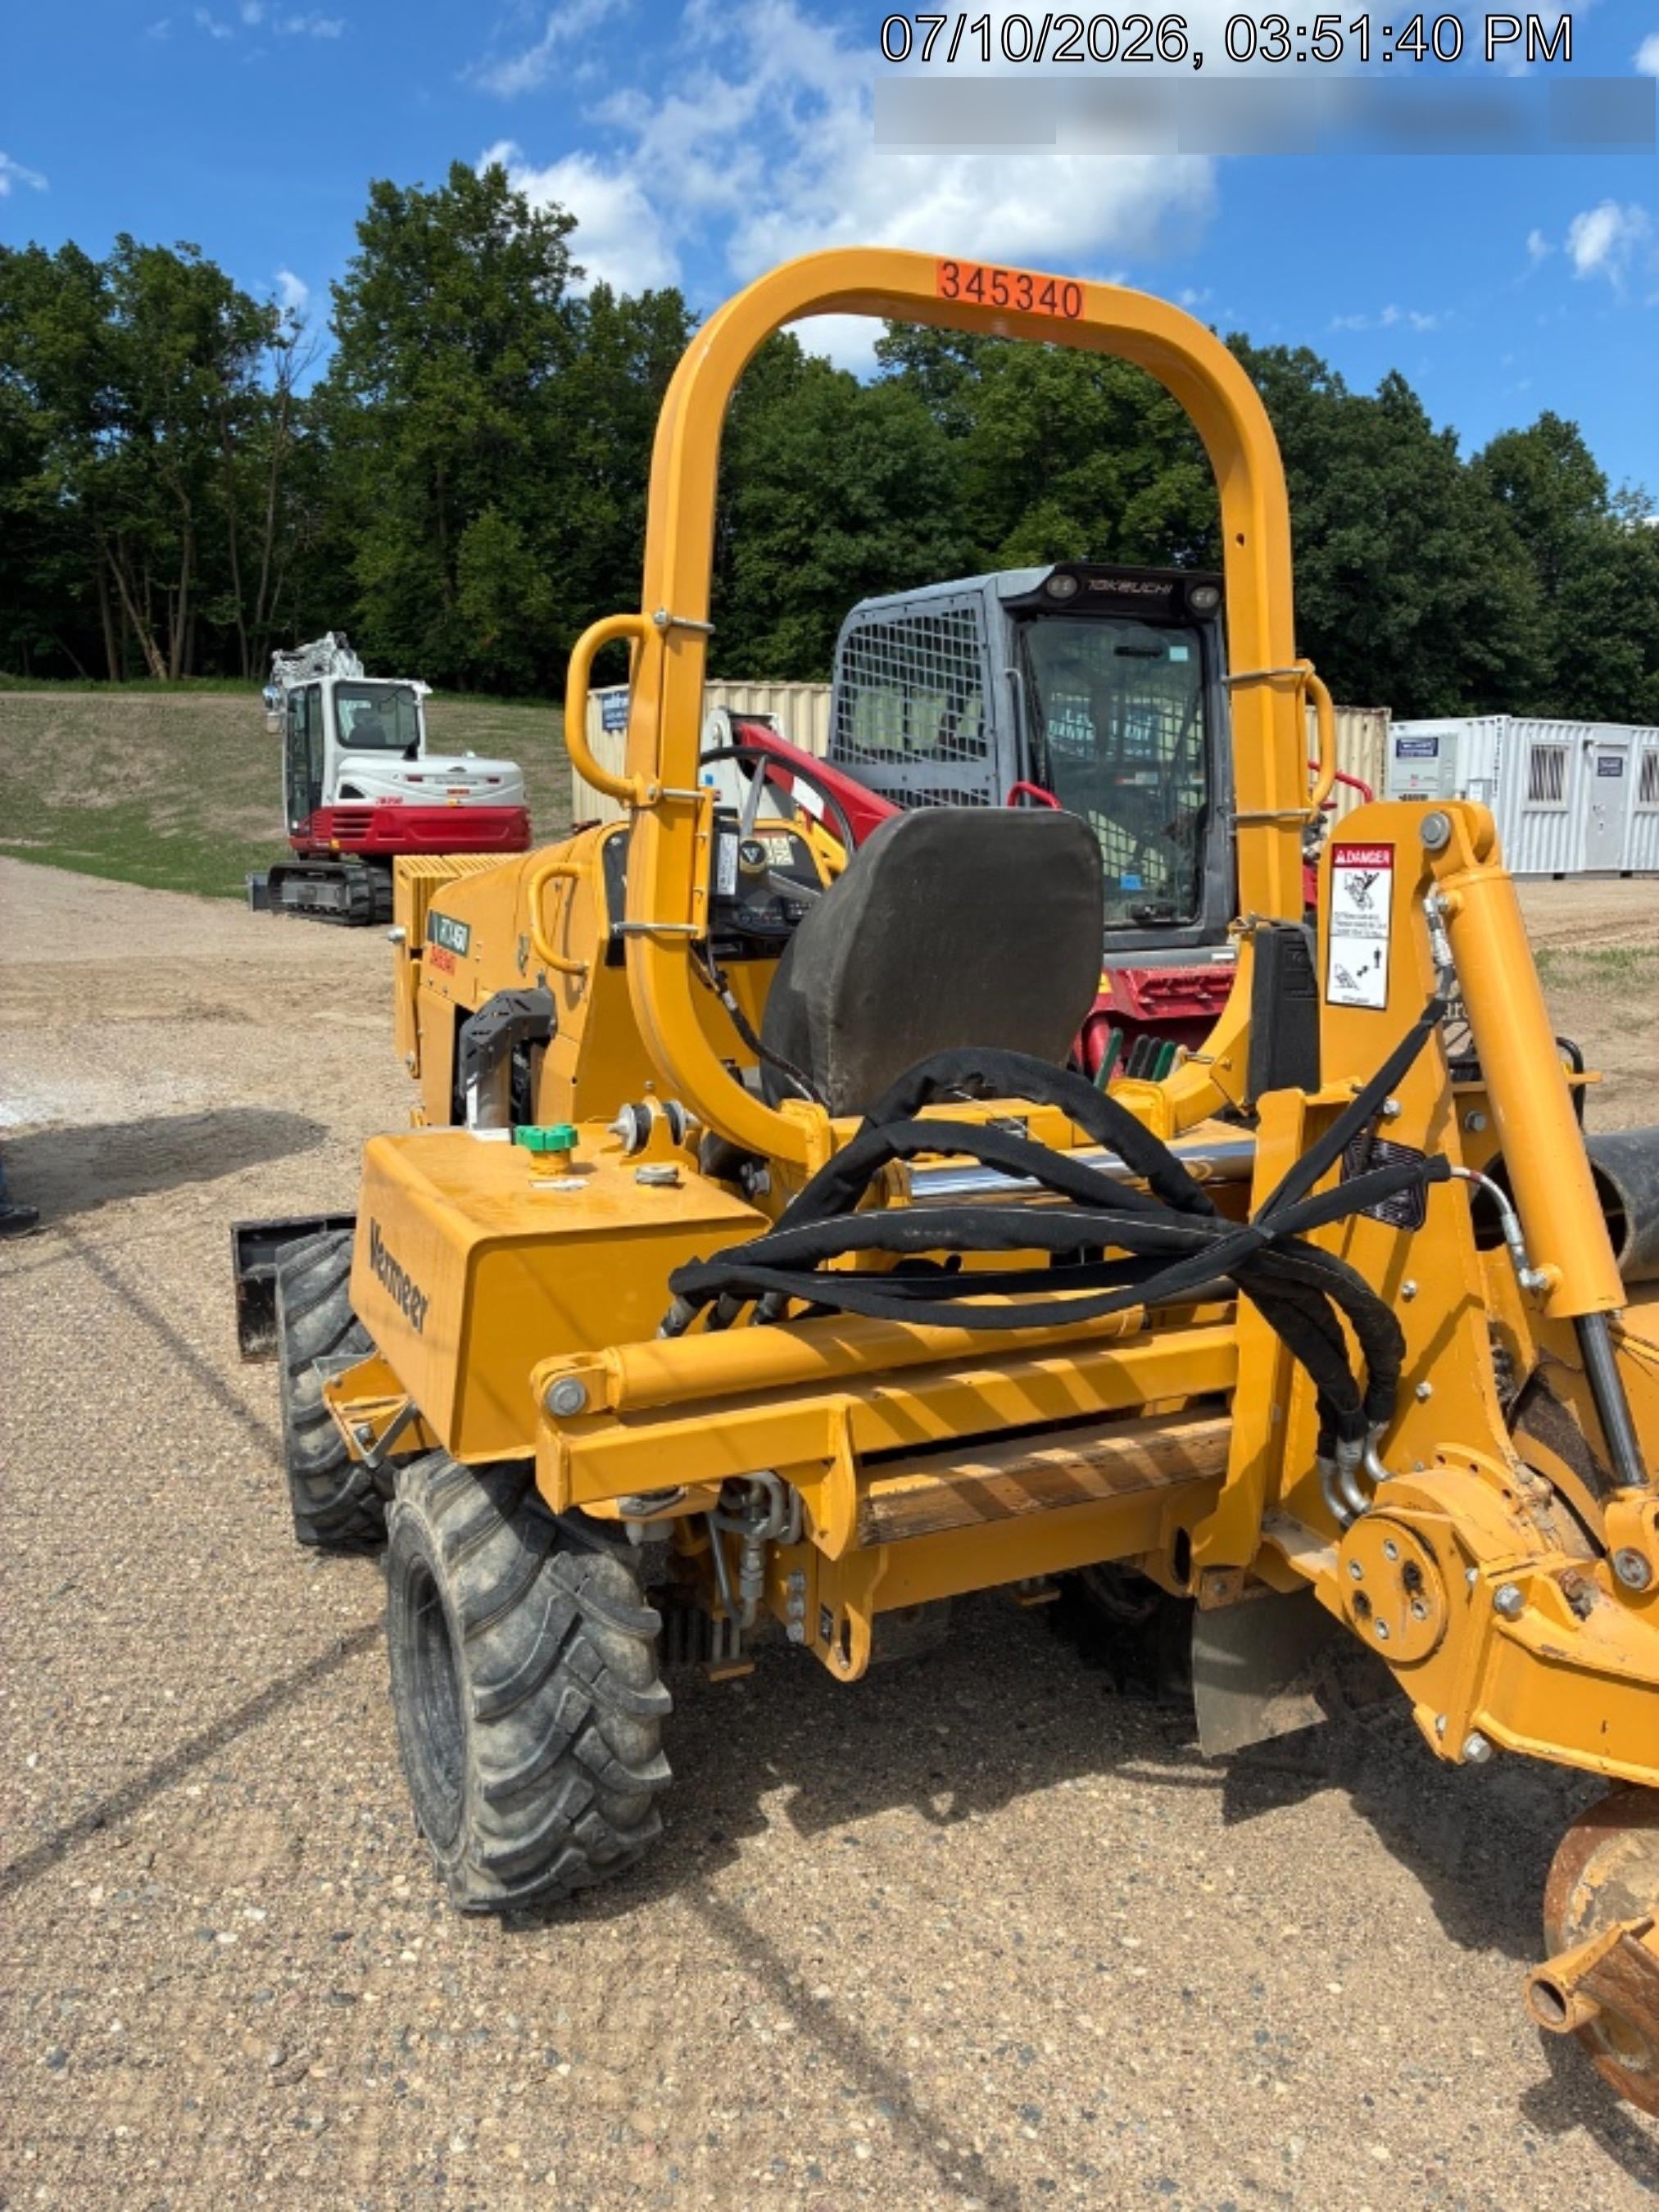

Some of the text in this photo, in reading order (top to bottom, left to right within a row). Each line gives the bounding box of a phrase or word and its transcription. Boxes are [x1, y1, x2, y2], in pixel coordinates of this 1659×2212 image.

[941, 261, 1082, 319] 345340
[1346, 850, 1390, 864] DANGER
[370, 1216, 429, 1335] Vermeer
